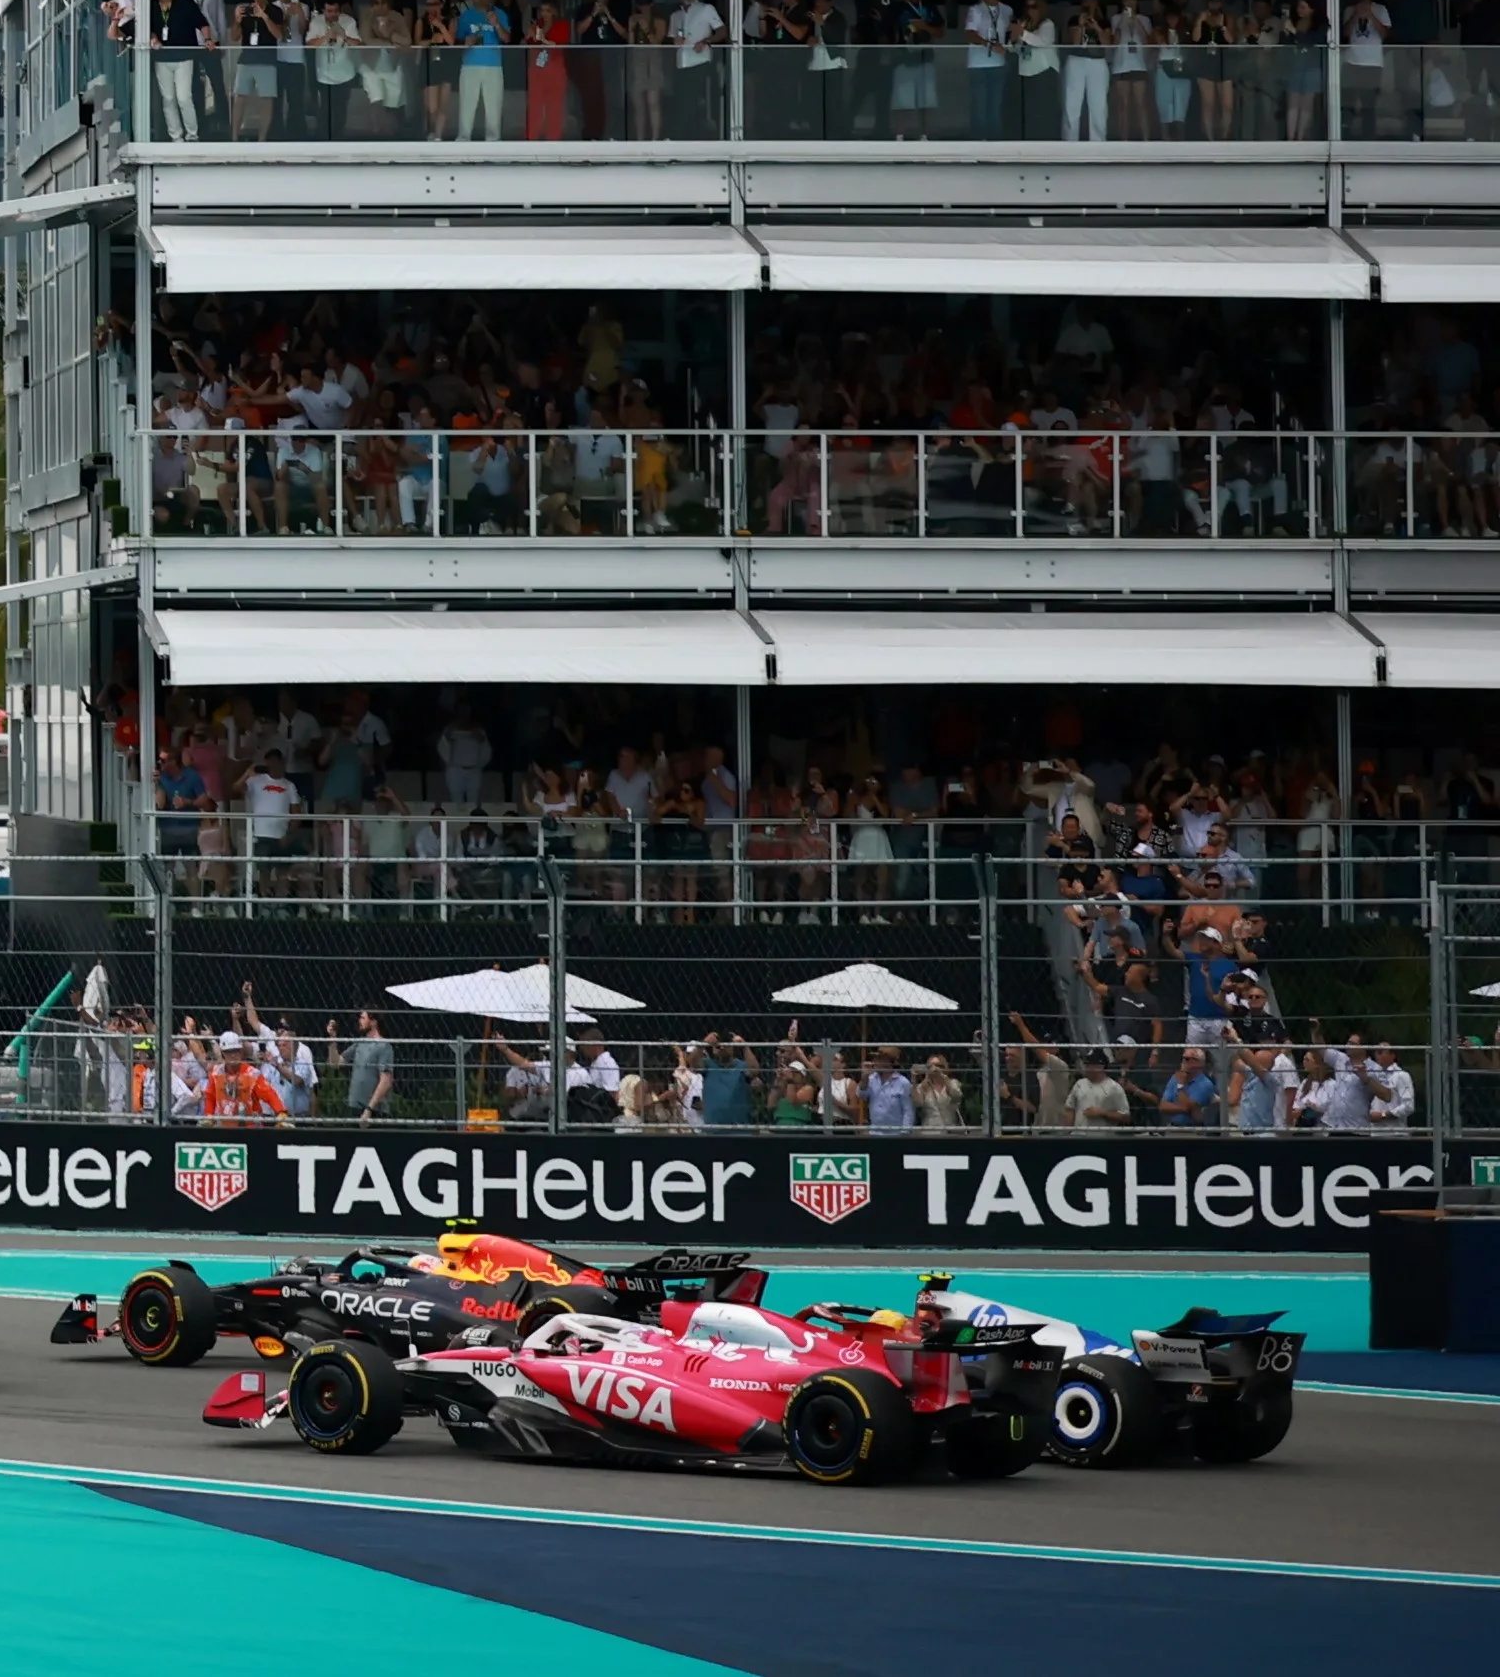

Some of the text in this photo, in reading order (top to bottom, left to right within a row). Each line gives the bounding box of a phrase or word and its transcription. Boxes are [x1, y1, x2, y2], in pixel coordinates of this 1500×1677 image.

[179, 1145, 241, 1169] TAG
[793, 1157, 866, 1180] TAG
[177, 1171, 247, 1210] HEUER
[792, 1182, 869, 1222] HEUER
[654, 1254, 746, 1271] ORACLE
[321, 1289, 436, 1322] ORACLE
[460, 1297, 498, 1320] Red
[976, 1329, 1004, 1342] Cash
[1150, 1342, 1198, 1355] V-Power
[472, 1361, 517, 1378] HUGO
[627, 1355, 663, 1367] Cash App
[514, 1384, 545, 1399] Mobil
[709, 1377, 773, 1392] HONDA
[561, 1363, 678, 1434] VISA
